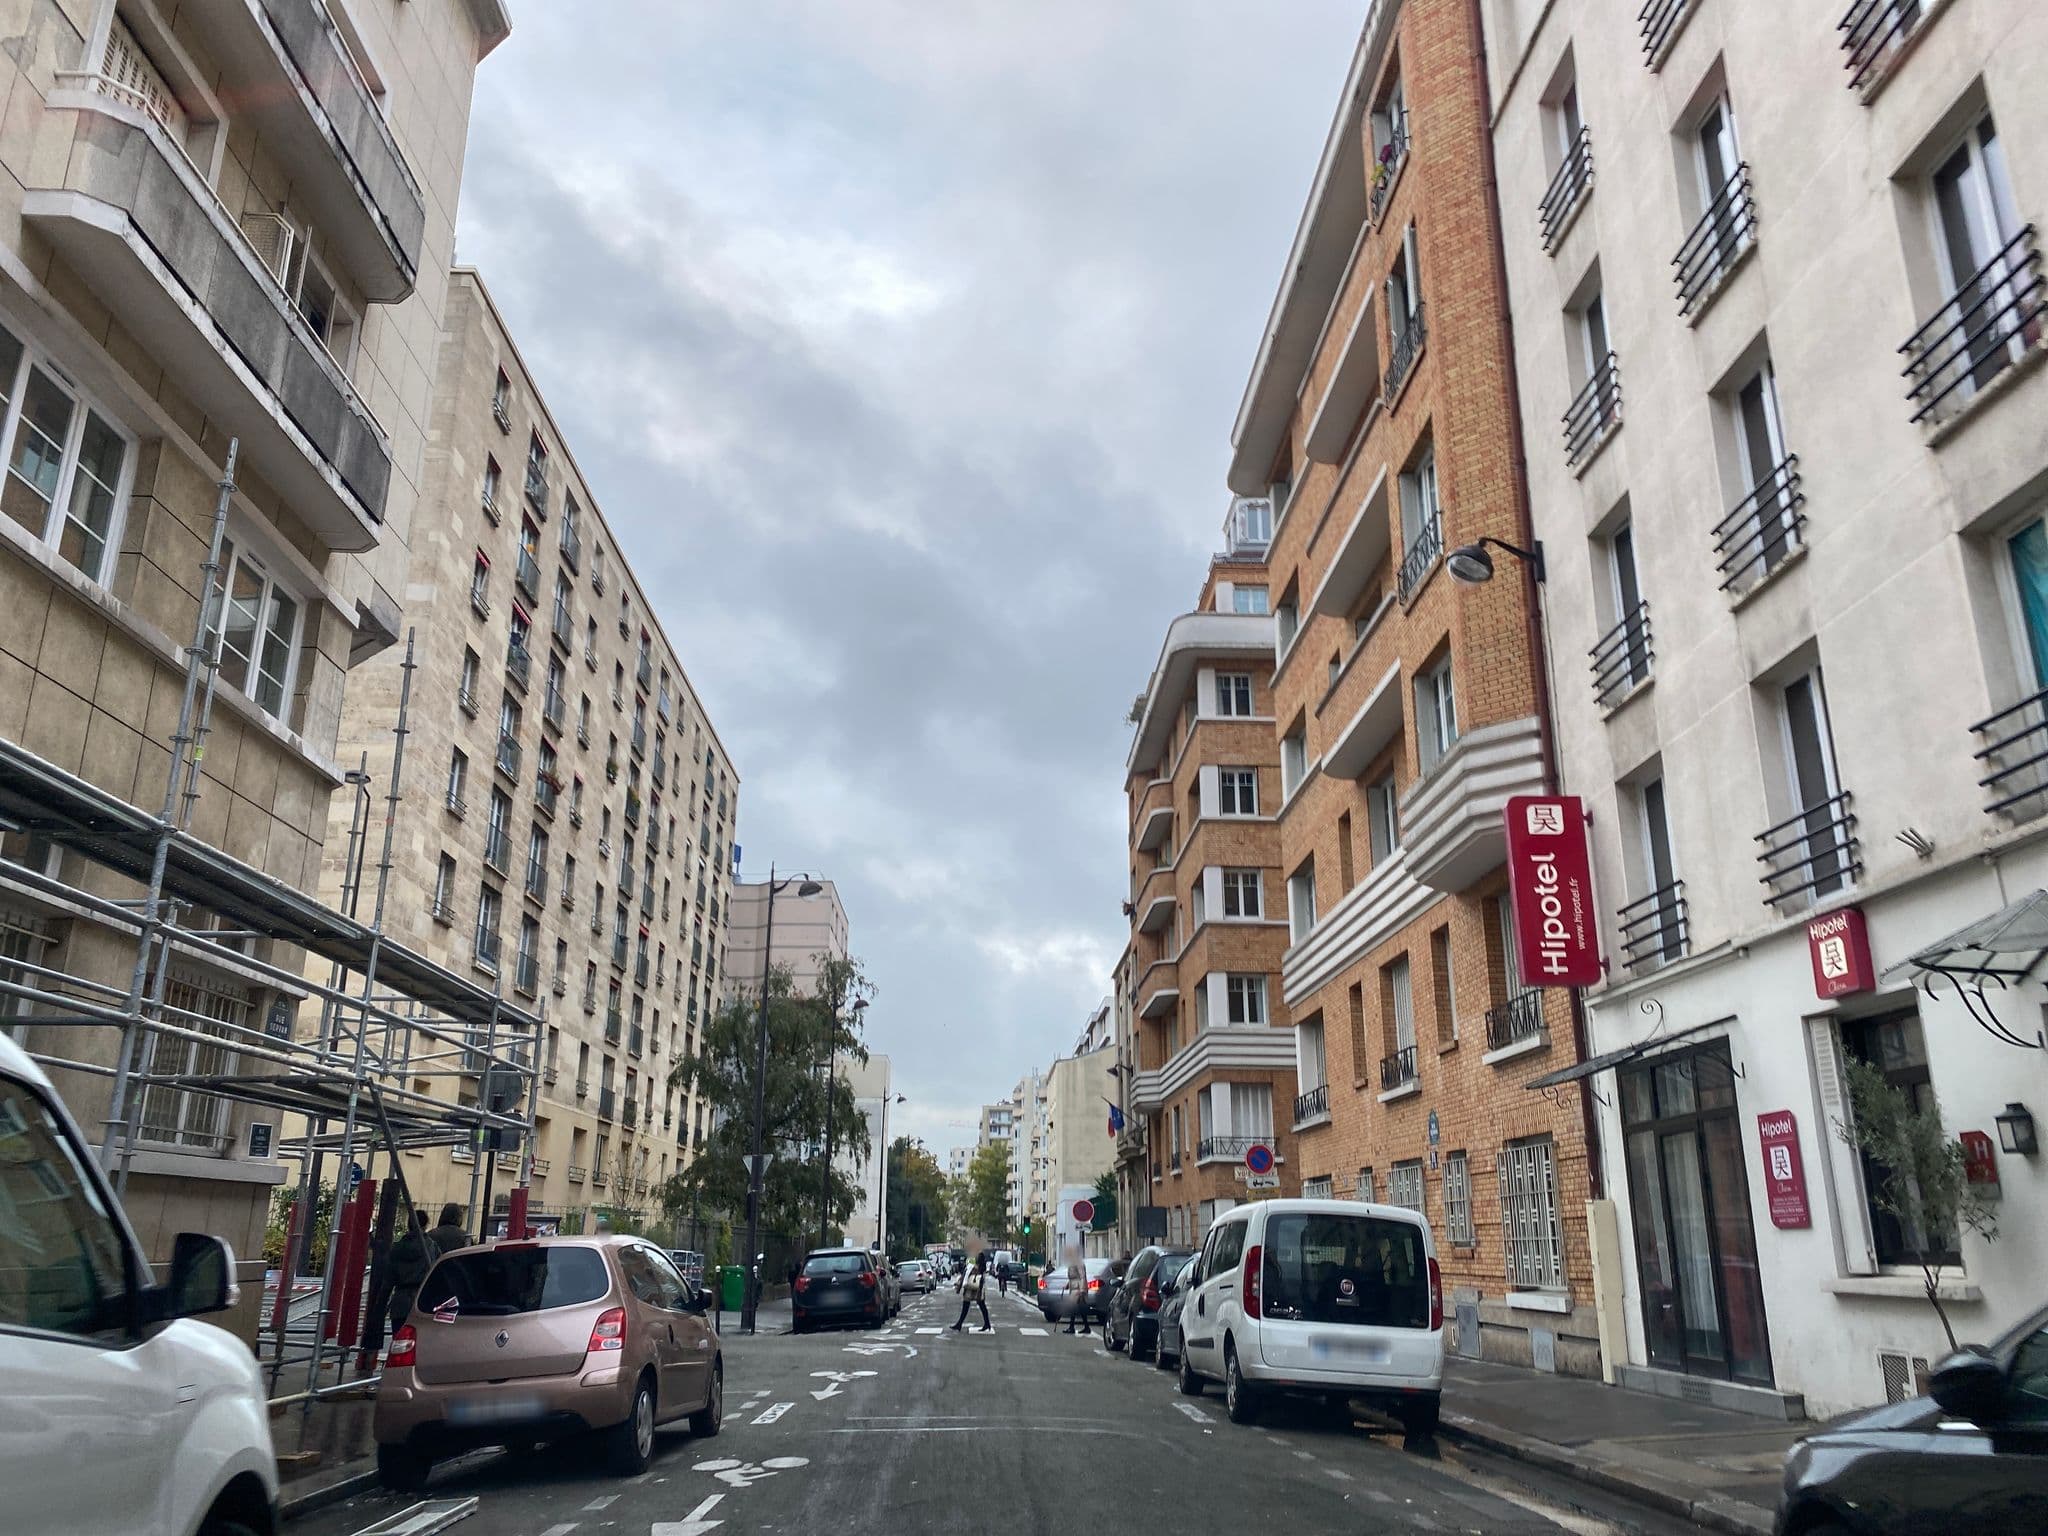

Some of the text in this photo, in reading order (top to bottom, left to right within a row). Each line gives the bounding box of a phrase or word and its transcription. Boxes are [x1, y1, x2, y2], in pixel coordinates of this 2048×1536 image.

[1530, 852, 1571, 976] Hipotel
[1569, 877, 1586, 951] www.hipotel.fr
[1810, 912, 1849, 941] Hipotel
[1761, 1118, 1793, 1139] Hipotel
